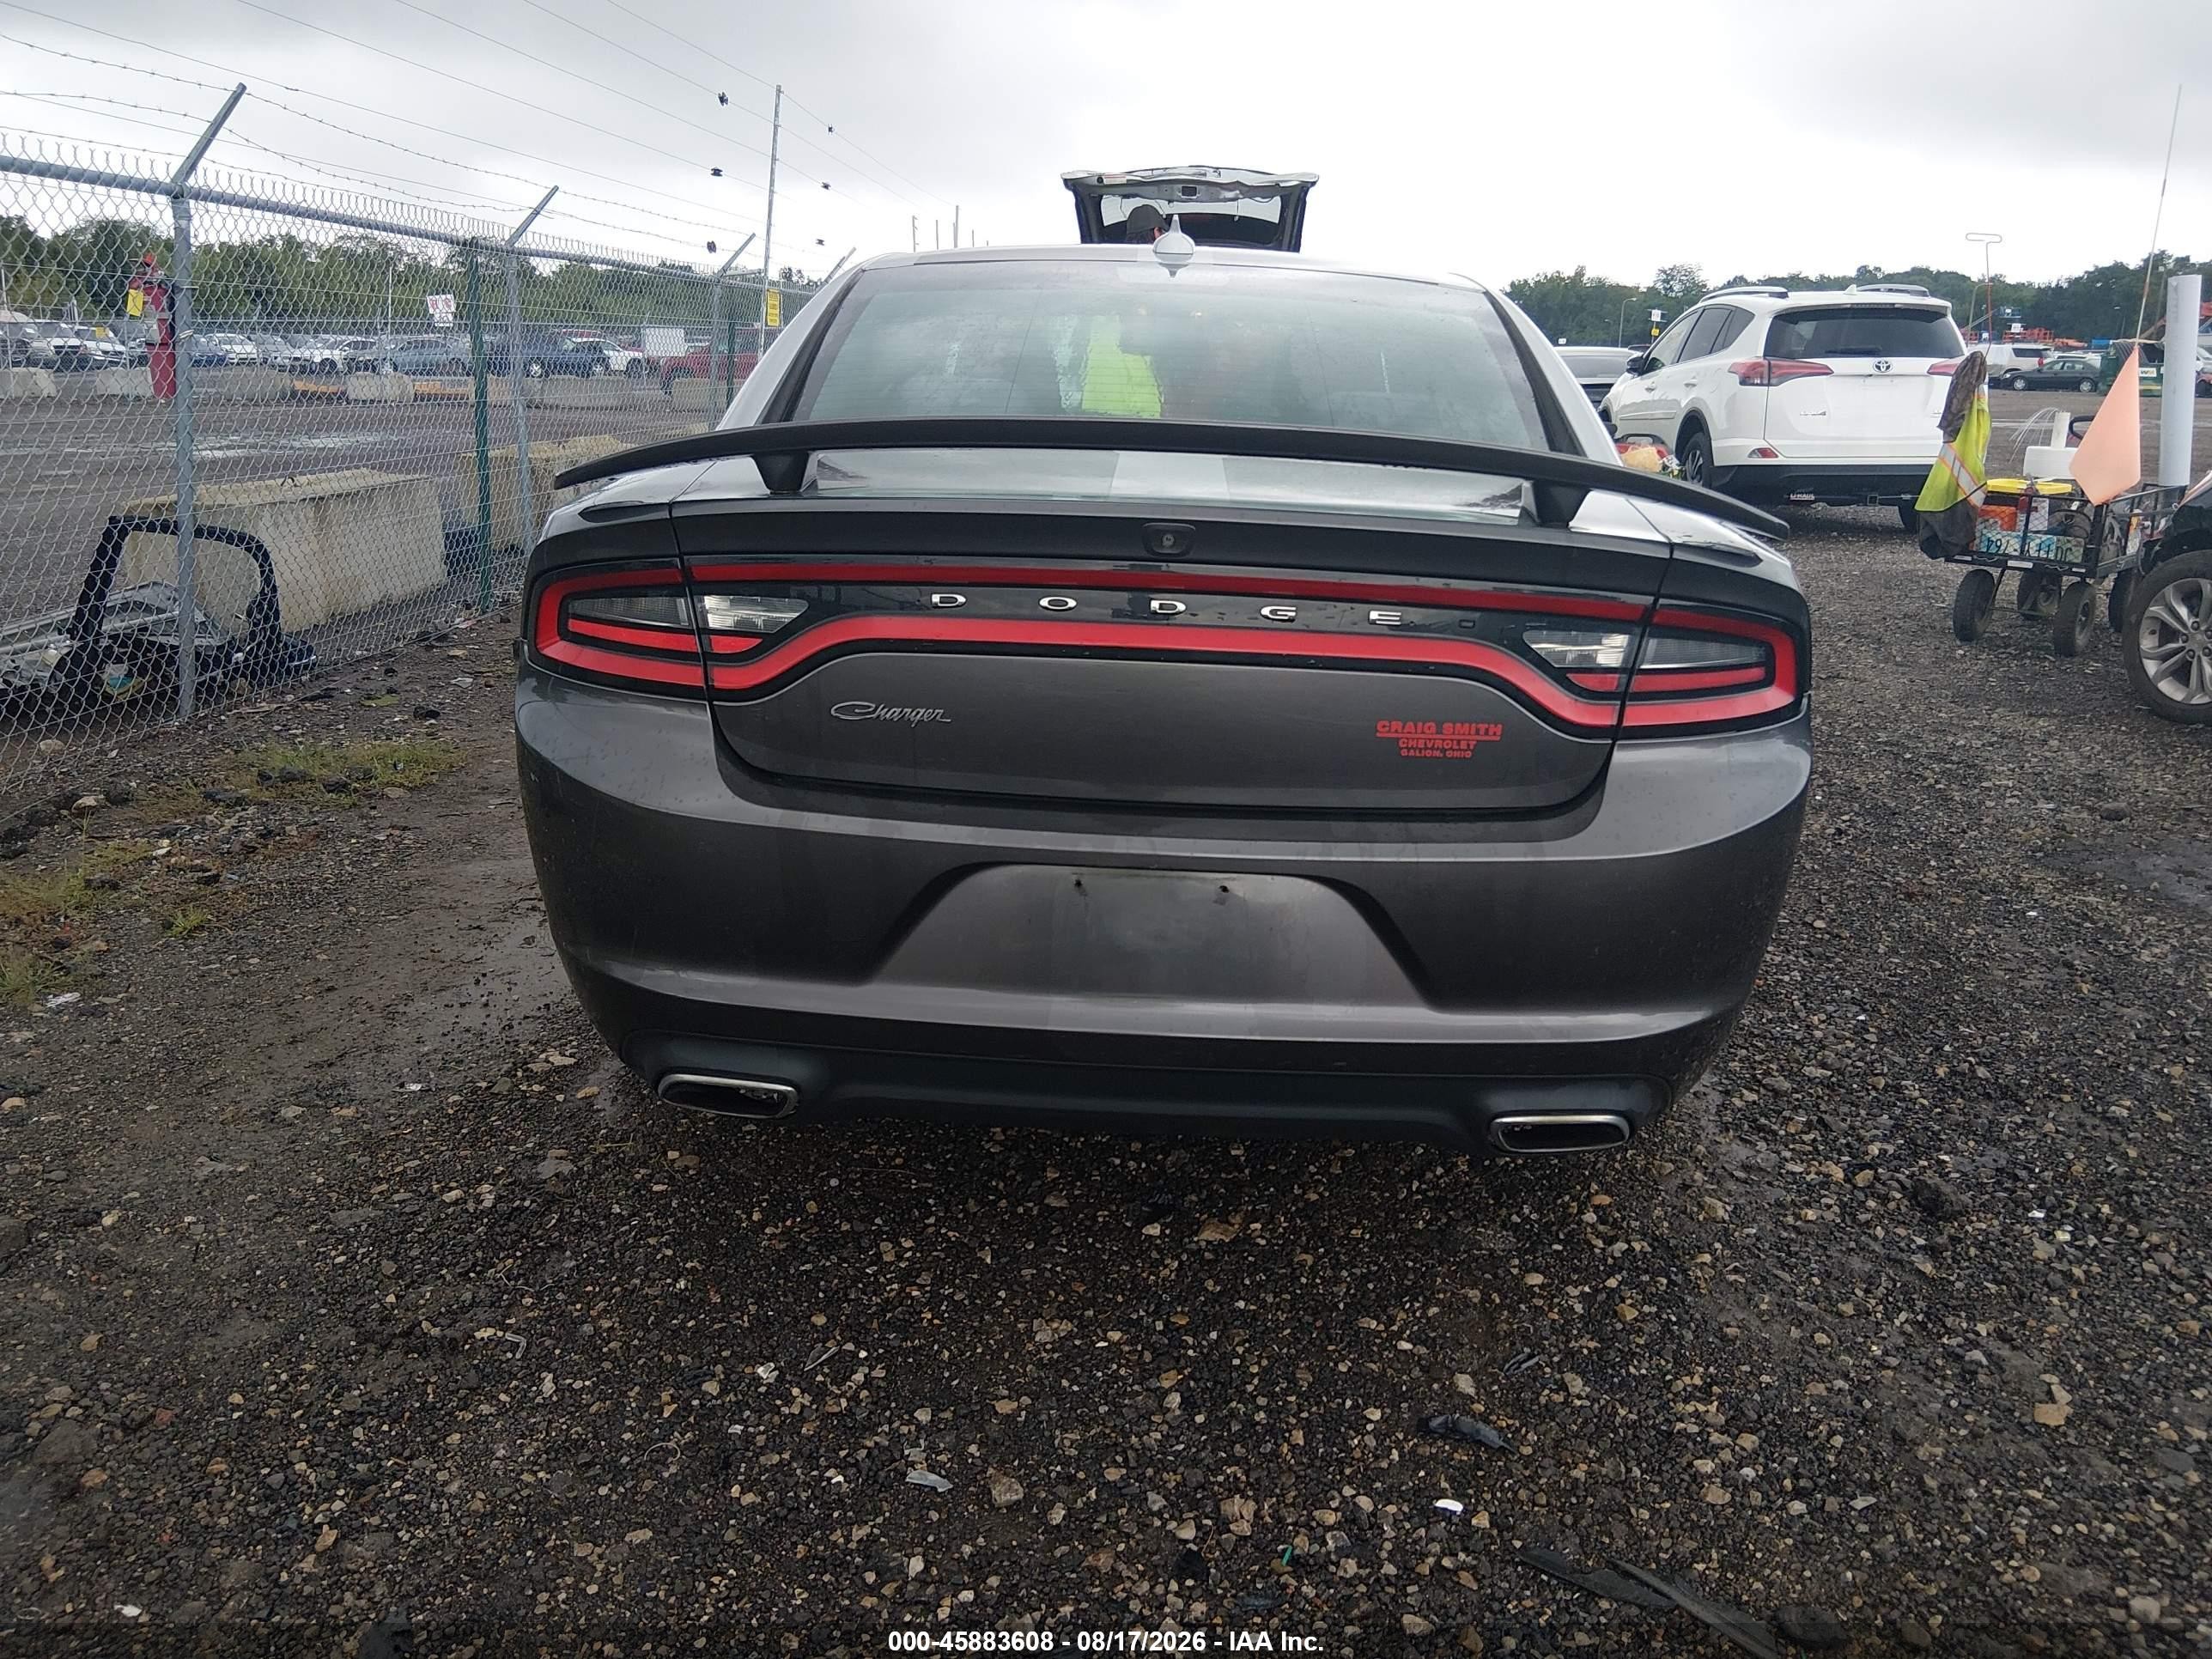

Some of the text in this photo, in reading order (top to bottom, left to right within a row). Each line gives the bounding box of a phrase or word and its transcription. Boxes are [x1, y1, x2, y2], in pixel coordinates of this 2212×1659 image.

[930, 592, 1403, 625] DODGE
[830, 701, 951, 728] Charger
[1376, 720, 1503, 736] CRAIG SMITH
[1398, 738, 1477, 750] CHEVROLET
[1401, 749, 1443, 757] GALION,
